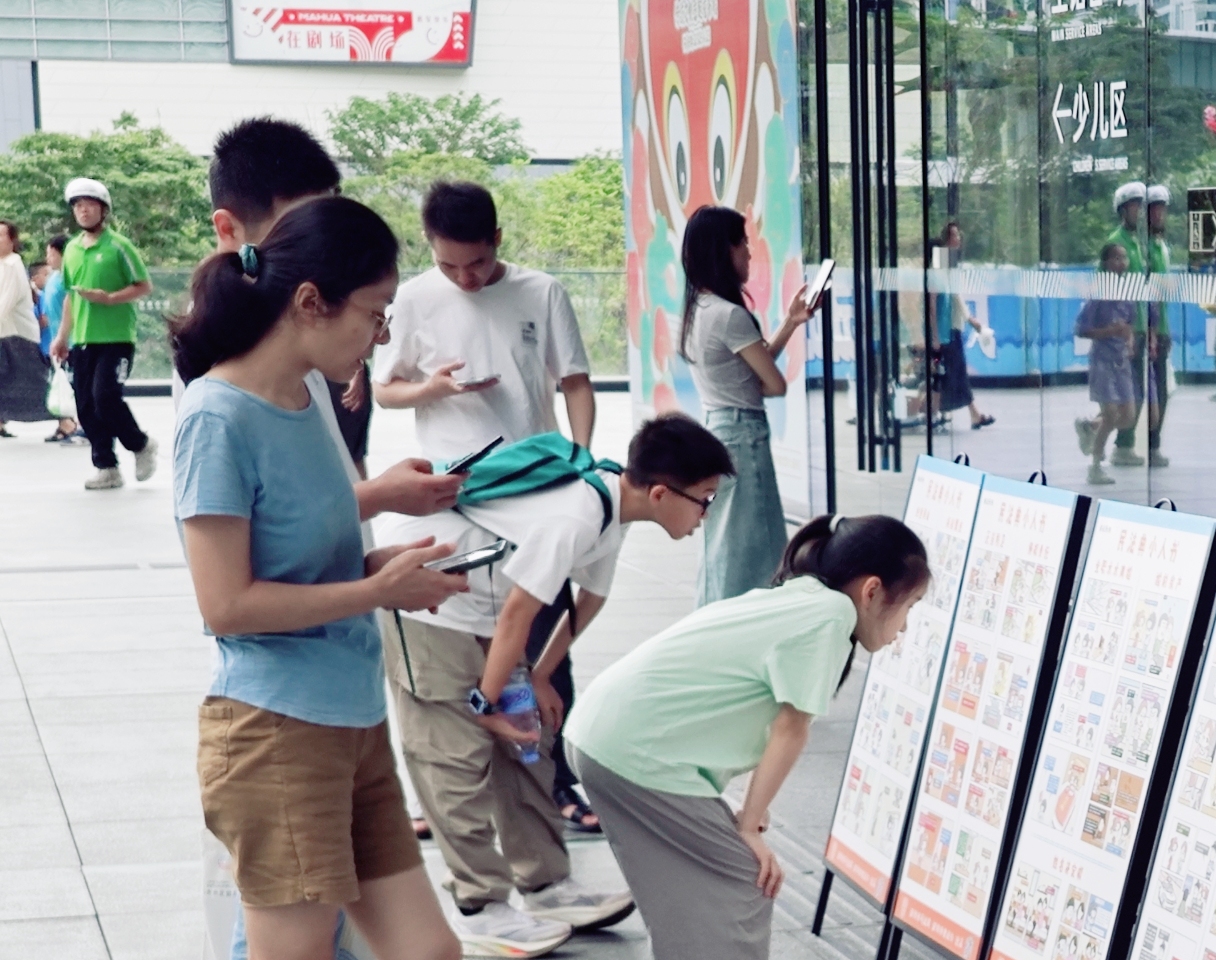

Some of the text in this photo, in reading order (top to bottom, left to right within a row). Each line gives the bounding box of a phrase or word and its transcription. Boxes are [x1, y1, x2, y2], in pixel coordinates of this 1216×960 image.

[298, 13, 394, 23] MAHUA THEATRE
[1072, 81, 1128, 143] 少儿区
